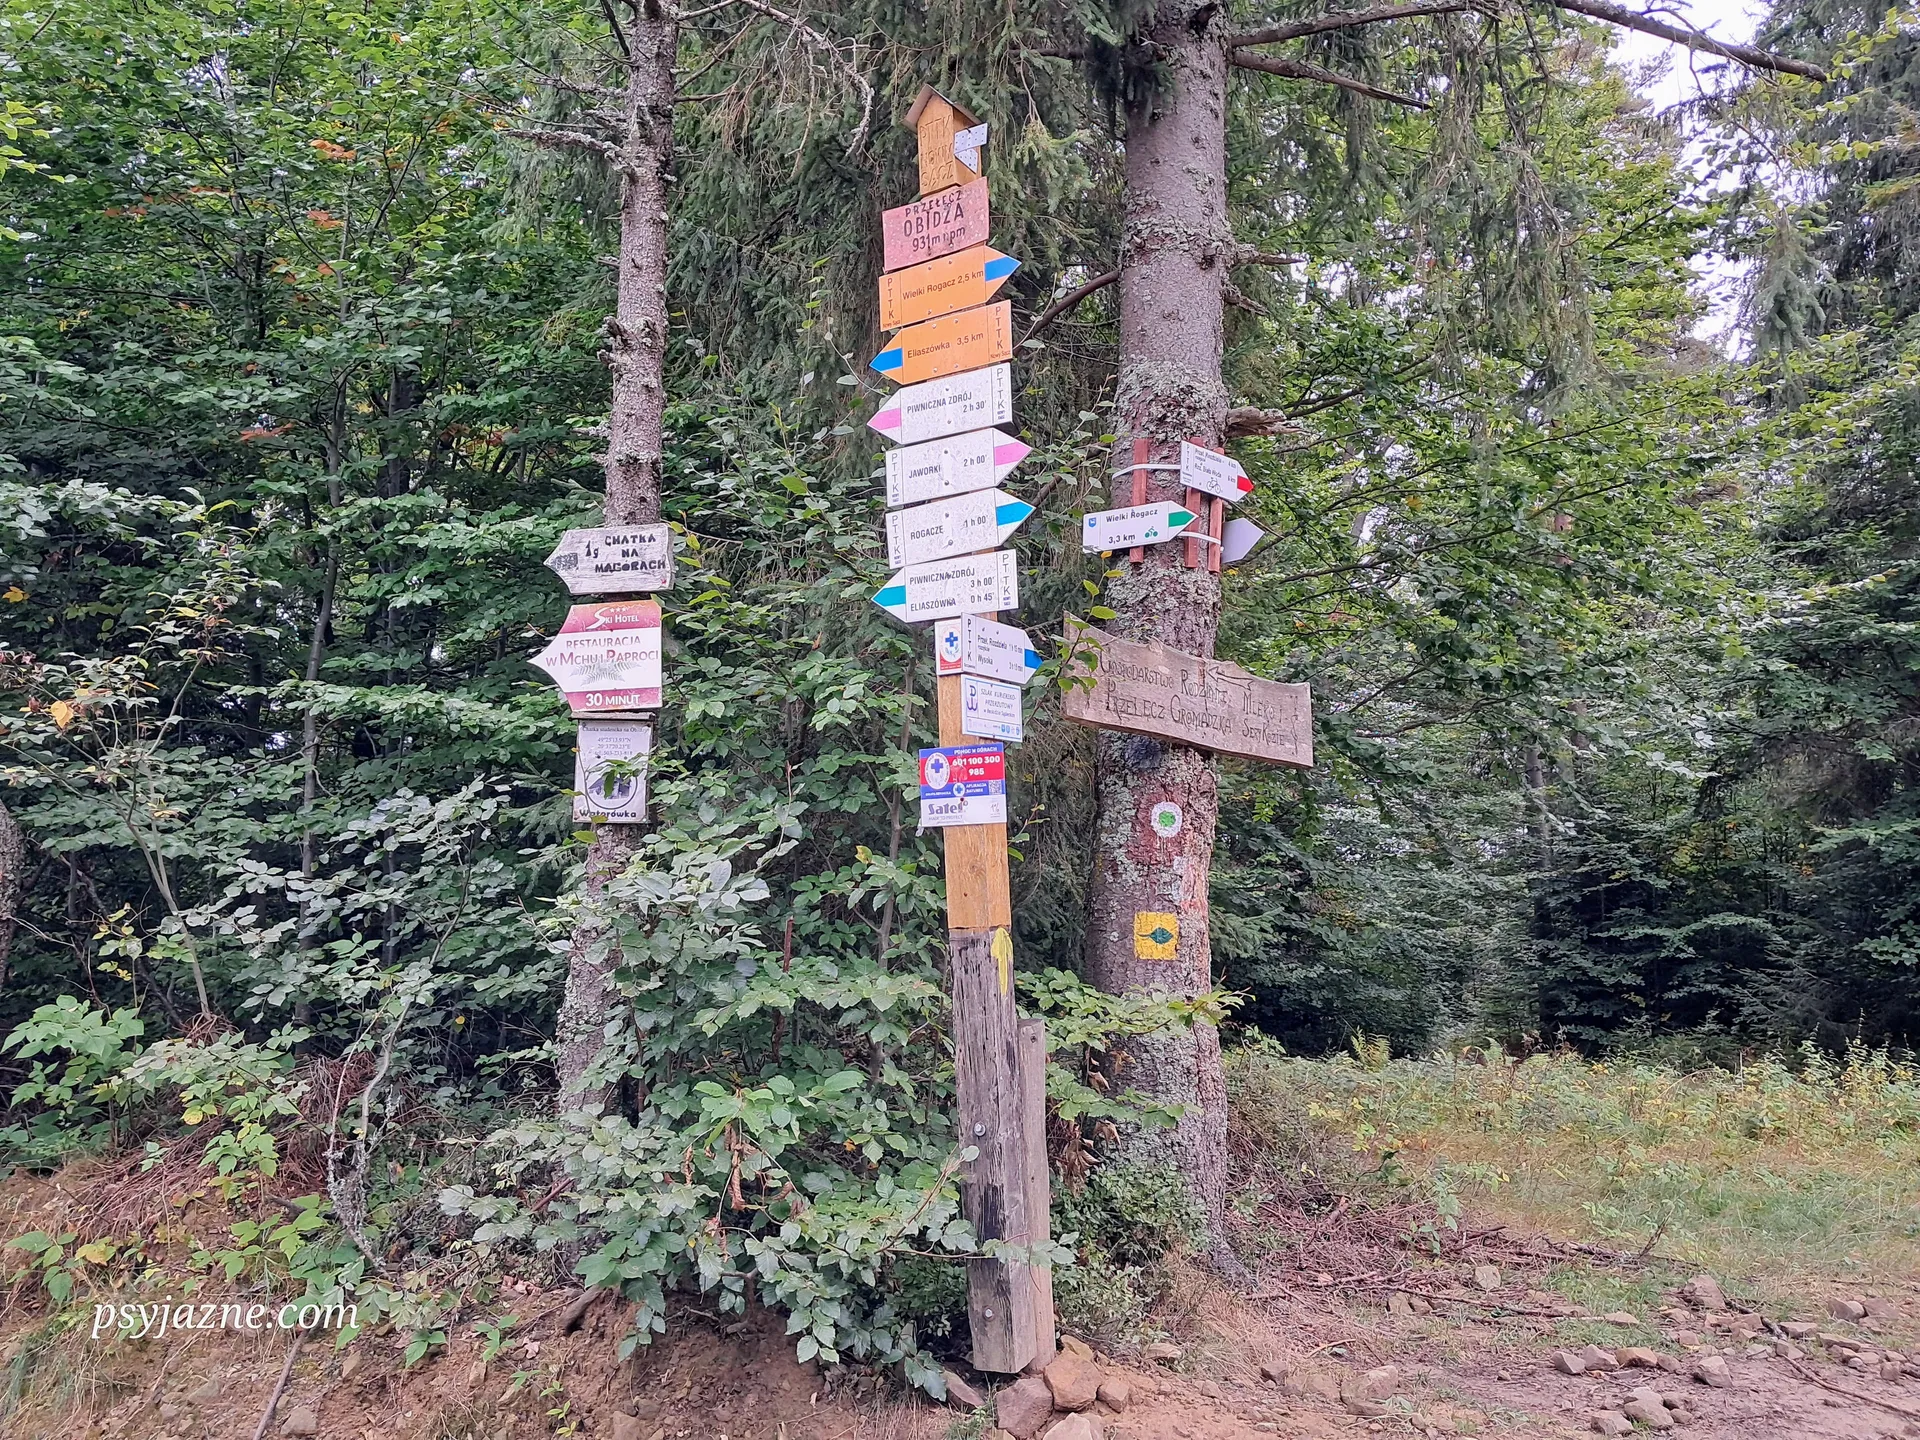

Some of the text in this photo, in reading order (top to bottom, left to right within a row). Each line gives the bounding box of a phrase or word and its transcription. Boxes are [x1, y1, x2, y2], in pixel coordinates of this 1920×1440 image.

[903, 203, 964, 237] OBIDZA
[902, 269, 984, 300] Wielki Rogacz 2,5 km
[887, 277, 895, 319] PTTK
[995, 306, 1004, 350] PTTK
[907, 332, 984, 359] Eliaszówka 3,5 km
[996, 367, 1006, 409] PTTK
[907, 390, 972, 414] PIWNICZNA ZDRÓJ
[962, 404, 968, 413] 2
[969, 403, 974, 412] h
[891, 453, 899, 492] PTTK
[908, 464, 941, 479] JAWORKI
[963, 459, 968, 467] 2
[970, 457, 975, 466] h
[1105, 510, 1158, 523] Wielki Rogacz
[605, 533, 656, 547] CHATKA
[891, 515, 901, 554] PTTK
[910, 525, 944, 541] ROGACZE
[964, 519, 968, 528] 1
[970, 518, 976, 527] h
[1108, 533, 1136, 545] 3,3 km
[621, 548, 639, 558] NA
[909, 566, 975, 585] PIWNICZNA ZDRÓJ
[970, 579, 975, 588] 3
[977, 578, 982, 587] h
[1002, 553, 1011, 595] PTTK
[910, 597, 956, 612] ELIASZÓWKA
[970, 595, 976, 604] 0
[977, 594, 982, 603] h
[566, 635, 641, 649] RESTAURACJA
[585, 692, 641, 707] 30 MINUT
[1242, 691, 1275, 722] MLEKO
[1170, 694, 1232, 735] GROMADZKA
[952, 755, 1001, 767] 601 100 300
[968, 768, 985, 776] 985
[928, 801, 963, 815] Satel
